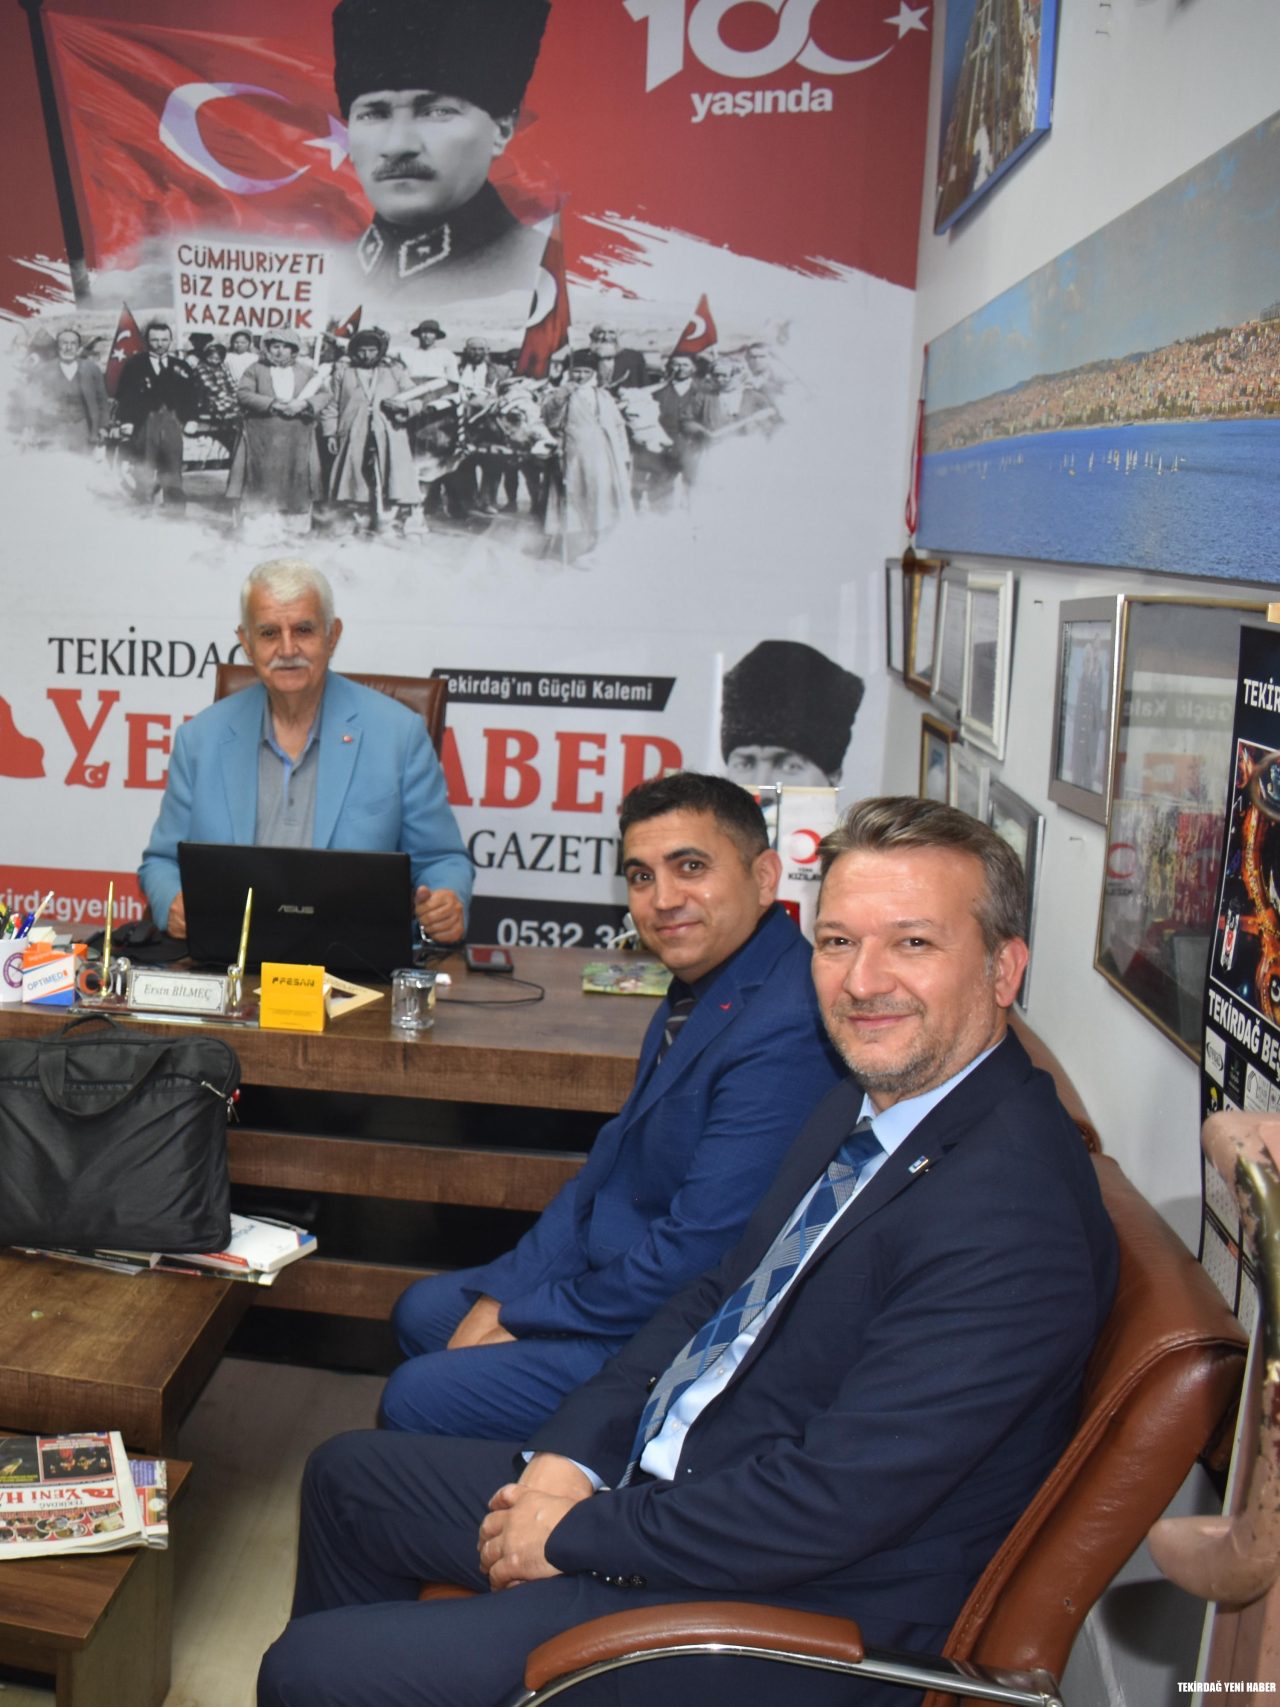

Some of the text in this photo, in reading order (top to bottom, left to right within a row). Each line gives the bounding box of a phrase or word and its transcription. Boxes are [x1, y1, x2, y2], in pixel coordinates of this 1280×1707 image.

[691, 82, 833, 123] yaşında
[181, 273, 313, 302] BİZ BÖYLE
[185, 302, 313, 329] KAZANDIK
[538, 678, 586, 702] Güçlü
[592, 681, 653, 702] Kalemi
[46, 688, 194, 790] YE
[440, 726, 685, 813] ABER
[788, 872, 822, 882] KIZILA
[278, 905, 314, 914] ASUS
[497, 918, 583, 948] 0532
[1209, 988, 1261, 1054] TEKİRDAĞ
[31, 1488, 81, 1503] YENİ
